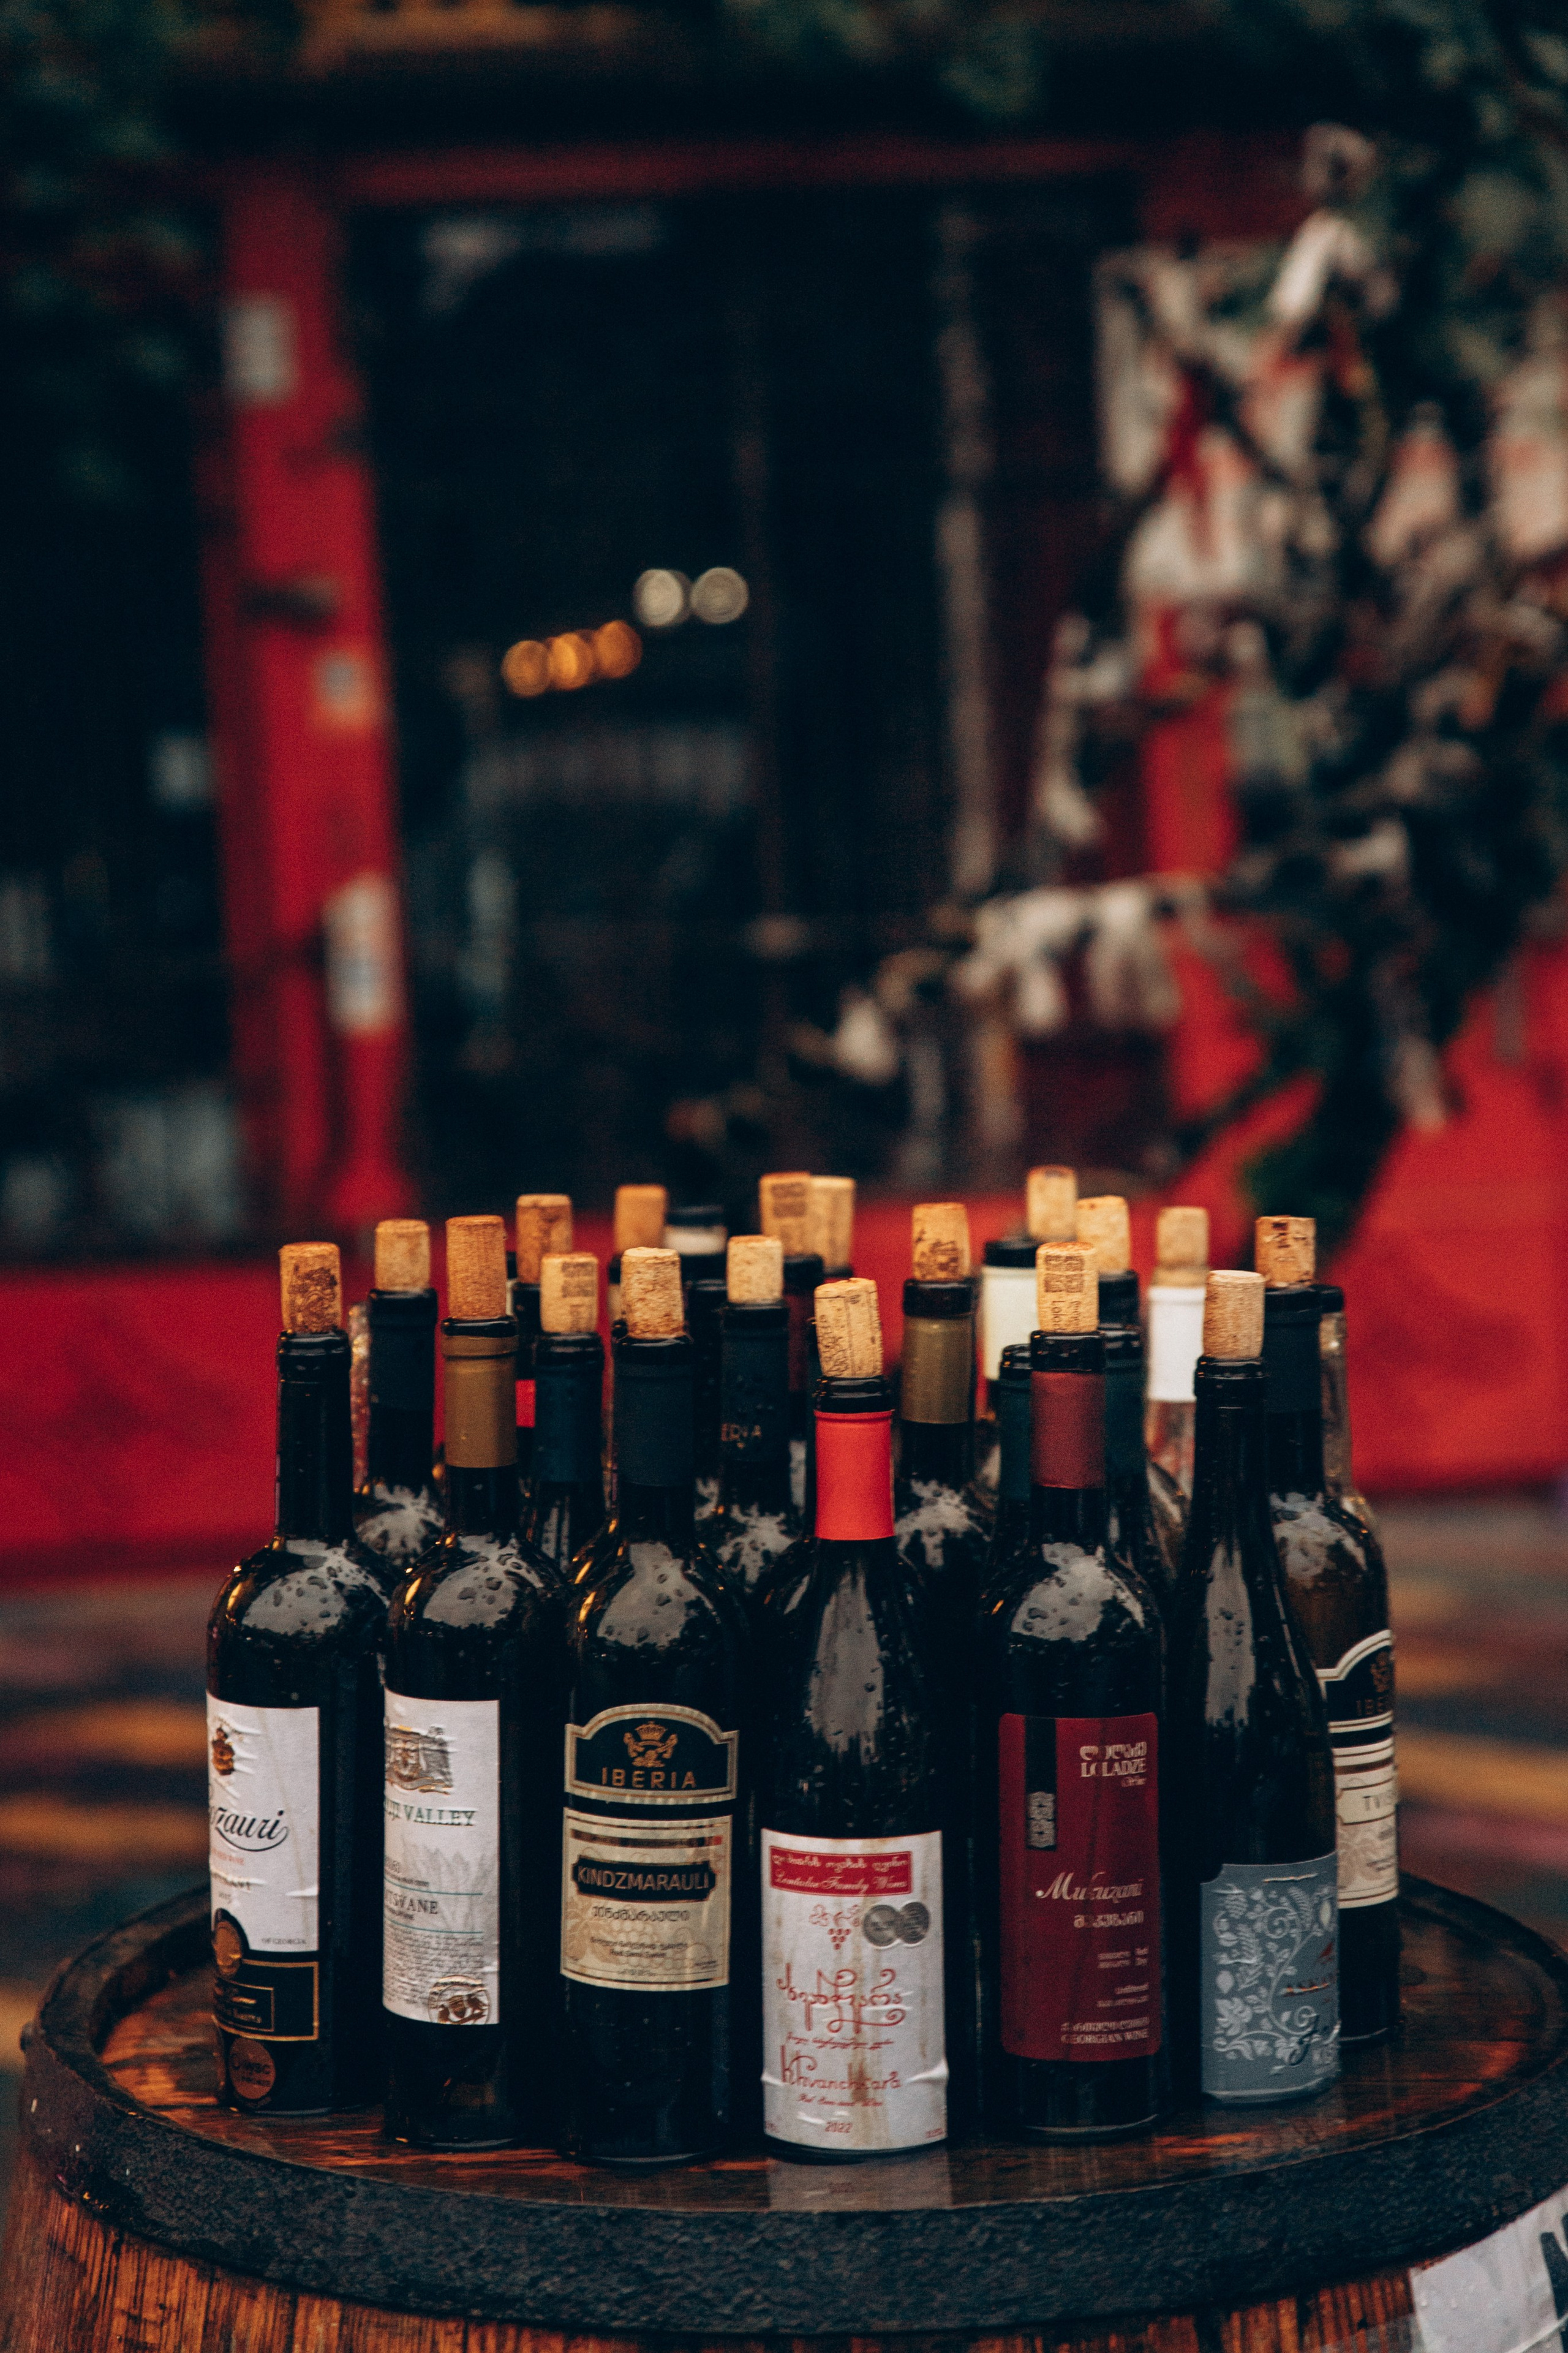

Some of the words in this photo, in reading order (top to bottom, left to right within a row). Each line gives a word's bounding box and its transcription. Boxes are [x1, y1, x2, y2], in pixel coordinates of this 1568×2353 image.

[602, 1767, 697, 1789] IBERIA
[403, 1805, 476, 1826] VALLEY
[578, 1865, 709, 1891] KINDZMARAULI
[385, 1889, 438, 1915] TSVANE
